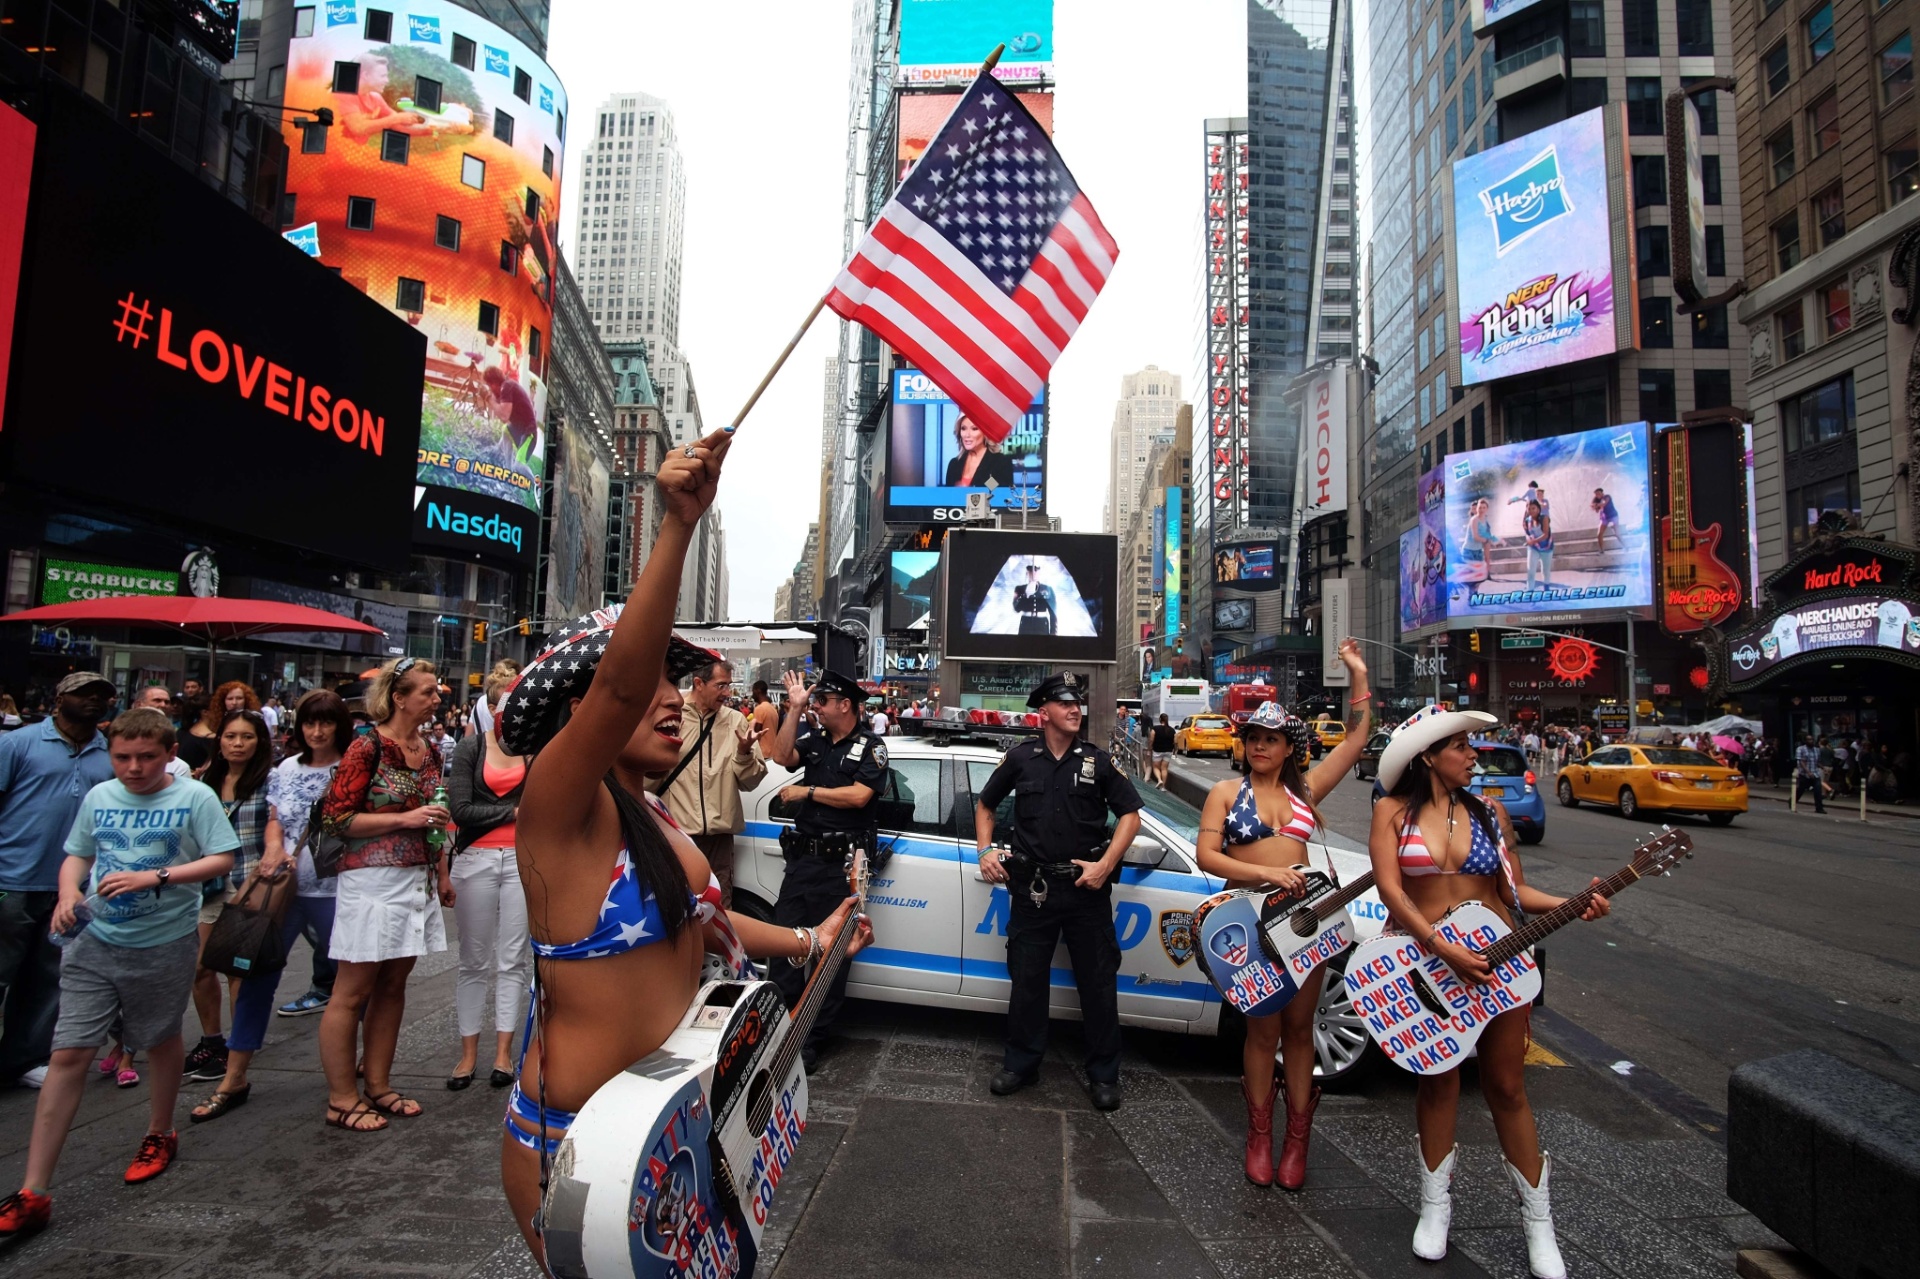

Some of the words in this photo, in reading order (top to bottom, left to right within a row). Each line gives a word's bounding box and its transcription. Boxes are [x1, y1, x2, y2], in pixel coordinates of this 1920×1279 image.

[409, 18, 442, 36] Hasbro
[990, 66, 1041, 79] ONUTS
[1487, 175, 1564, 217] Hasbro
[1505, 273, 1557, 310] NERF
[1478, 277, 1589, 352] Rebelle
[113, 292, 385, 457] #LOVEISON
[900, 375, 941, 392] FOX
[1316, 381, 1330, 505] RICOH
[417, 449, 453, 468] ORE
[455, 458, 470, 474] @
[473, 461, 531, 491] NERF.COM
[426, 502, 522, 553] Nasdaq
[47, 567, 175, 593] STARBUCKS
[1805, 565, 1842, 590] Hard
[1843, 558, 1882, 588] Rock
[1668, 589, 1702, 605] Hard
[1703, 588, 1737, 606] Rock
[1520, 615, 1552, 623] THOMSON
[1552, 613, 1582, 621] REUTERS
[1796, 602, 1879, 627] MERCHANDISE
[1801, 624, 1831, 635] AVAILABLE
[1833, 620, 1857, 631] ONLINE
[1857, 619, 1872, 629] AND
[685, 636, 748, 645] eOnTheNYPD.com
[1828, 632, 1845, 642] ROCK
[1844, 630, 1865, 640] SHOP
[1415, 653, 1448, 678] at&t
[1732, 650, 1747, 661] Hard
[1747, 649, 1760, 660] Rock
[972, 676, 988, 684] U.S.
[989, 676, 1014, 685] ARMED
[1014, 676, 1040, 686] FORCES
[978, 684, 1005, 693] CAREER
[1829, 695, 1847, 703] SHOP
[94, 808, 192, 829] DETROIT
[867, 894, 928, 910] SIONALISM
[1171, 912, 1192, 921] POLIC
[1348, 899, 1386, 921] LIC
[1292, 932, 1349, 975] COWGIRL
[1396, 922, 1467, 967] COWIRL
[1454, 924, 1497, 953] KED
[1226, 960, 1284, 1004] COWGIRL
[1231, 959, 1262, 985] NAKED
[1344, 954, 1396, 993] NAKED
[1424, 956, 1470, 1010] NAKED
[1239, 977, 1283, 1012] NAKED
[1369, 995, 1421, 1035] NAKED
[1450, 986, 1522, 1034] COWGIRL
[1381, 1013, 1450, 1060] COWGIRL
[1406, 1036, 1460, 1075] NAKED
[638, 1095, 690, 1200] PATTY
[751, 1089, 793, 1181] NAKED
[752, 1109, 807, 1227] COWGIRL
